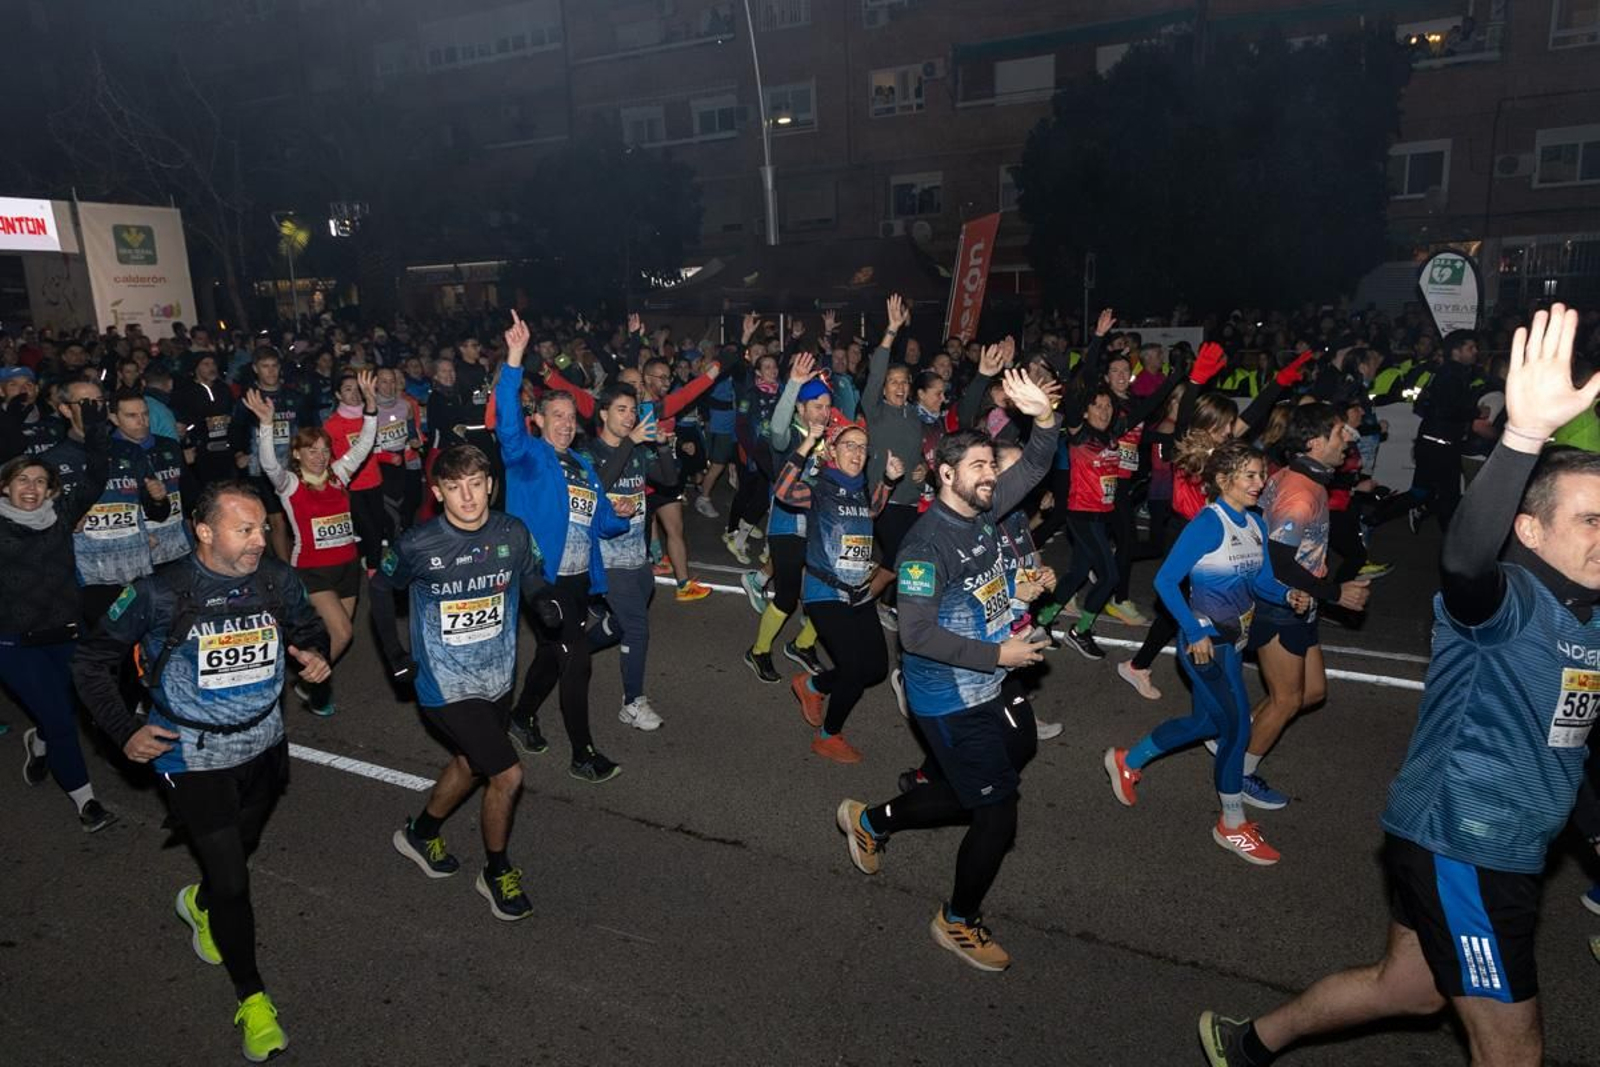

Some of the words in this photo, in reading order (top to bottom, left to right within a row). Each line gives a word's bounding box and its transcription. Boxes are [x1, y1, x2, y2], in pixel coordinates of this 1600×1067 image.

[571, 496, 594, 513] 638
[88, 512, 133, 526] 9125
[431, 580, 463, 596] SAN
[467, 569, 513, 592] ANTÓN
[447, 607, 499, 629] 7324
[187, 621, 216, 641] AN
[206, 642, 269, 668] 6951
[1563, 692, 1600, 718] 587
